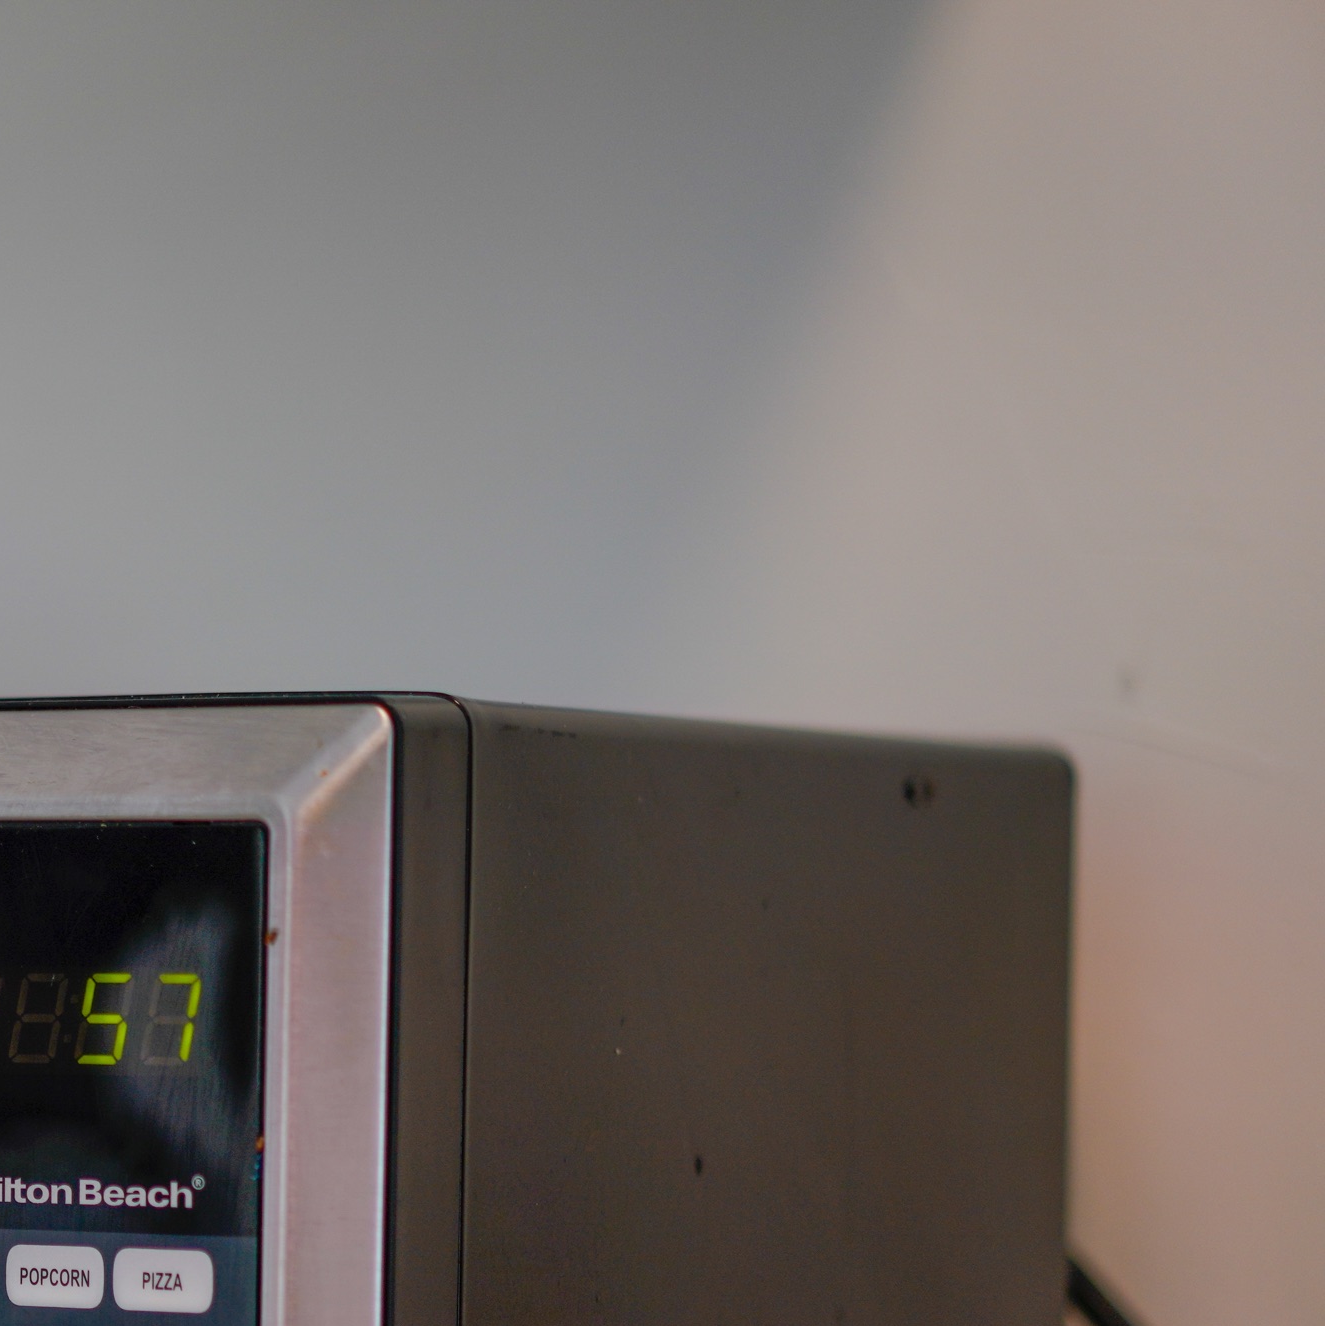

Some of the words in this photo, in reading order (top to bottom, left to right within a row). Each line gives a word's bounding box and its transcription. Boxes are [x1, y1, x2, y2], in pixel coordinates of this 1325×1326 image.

[77, 972, 202, 1066] 57
[19, 1267, 90, 1288] POPCORN
[142, 1271, 183, 1291] PIZZA
